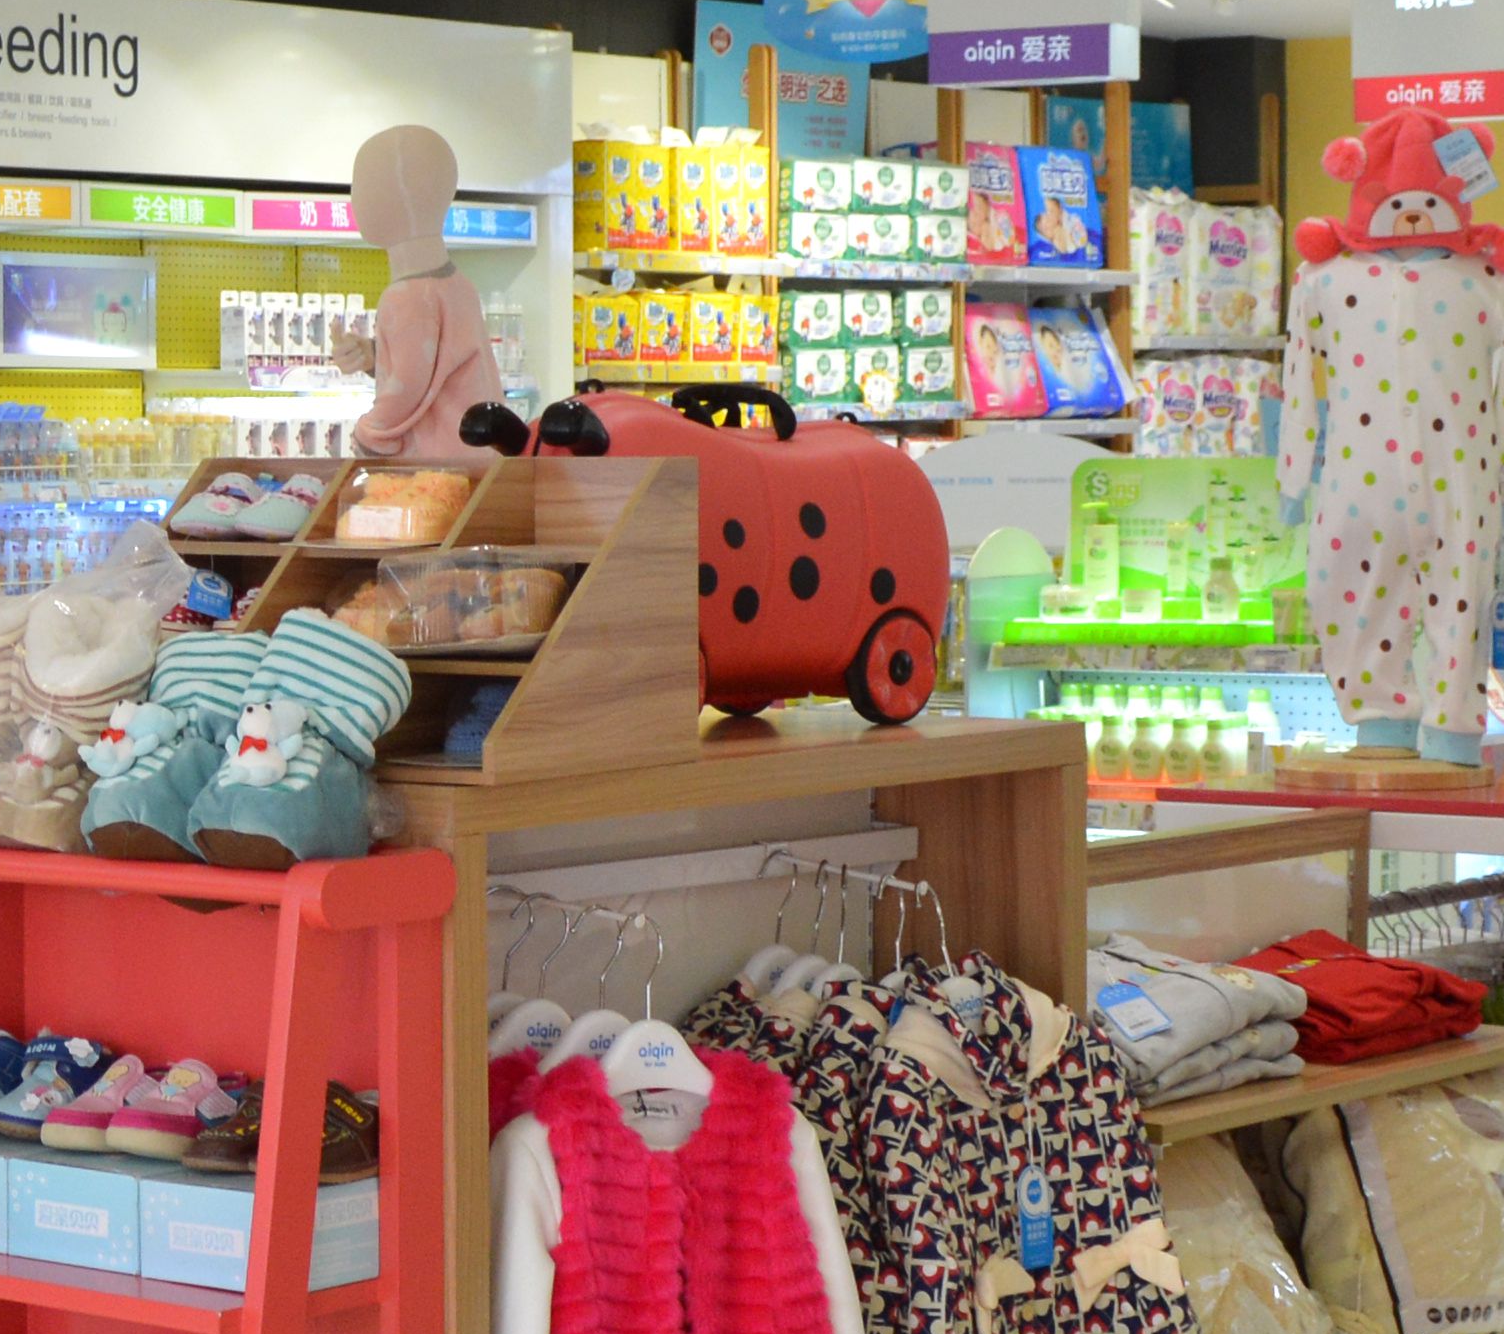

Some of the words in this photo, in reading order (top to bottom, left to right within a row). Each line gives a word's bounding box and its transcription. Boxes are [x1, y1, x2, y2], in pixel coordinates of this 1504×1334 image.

[964, 38, 1015, 65] aiqin
[1021, 34, 1072, 64] 爱亲
[1386, 82, 1434, 105] aiqin
[1439, 77, 1486, 104] 爱亲
[131, 194, 206, 226] 安全健康
[299, 200, 350, 229] 奶瓶
[526, 1023, 562, 1042] aiqin
[588, 1034, 618, 1054] aiqi
[638, 1042, 674, 1060] aiqin
